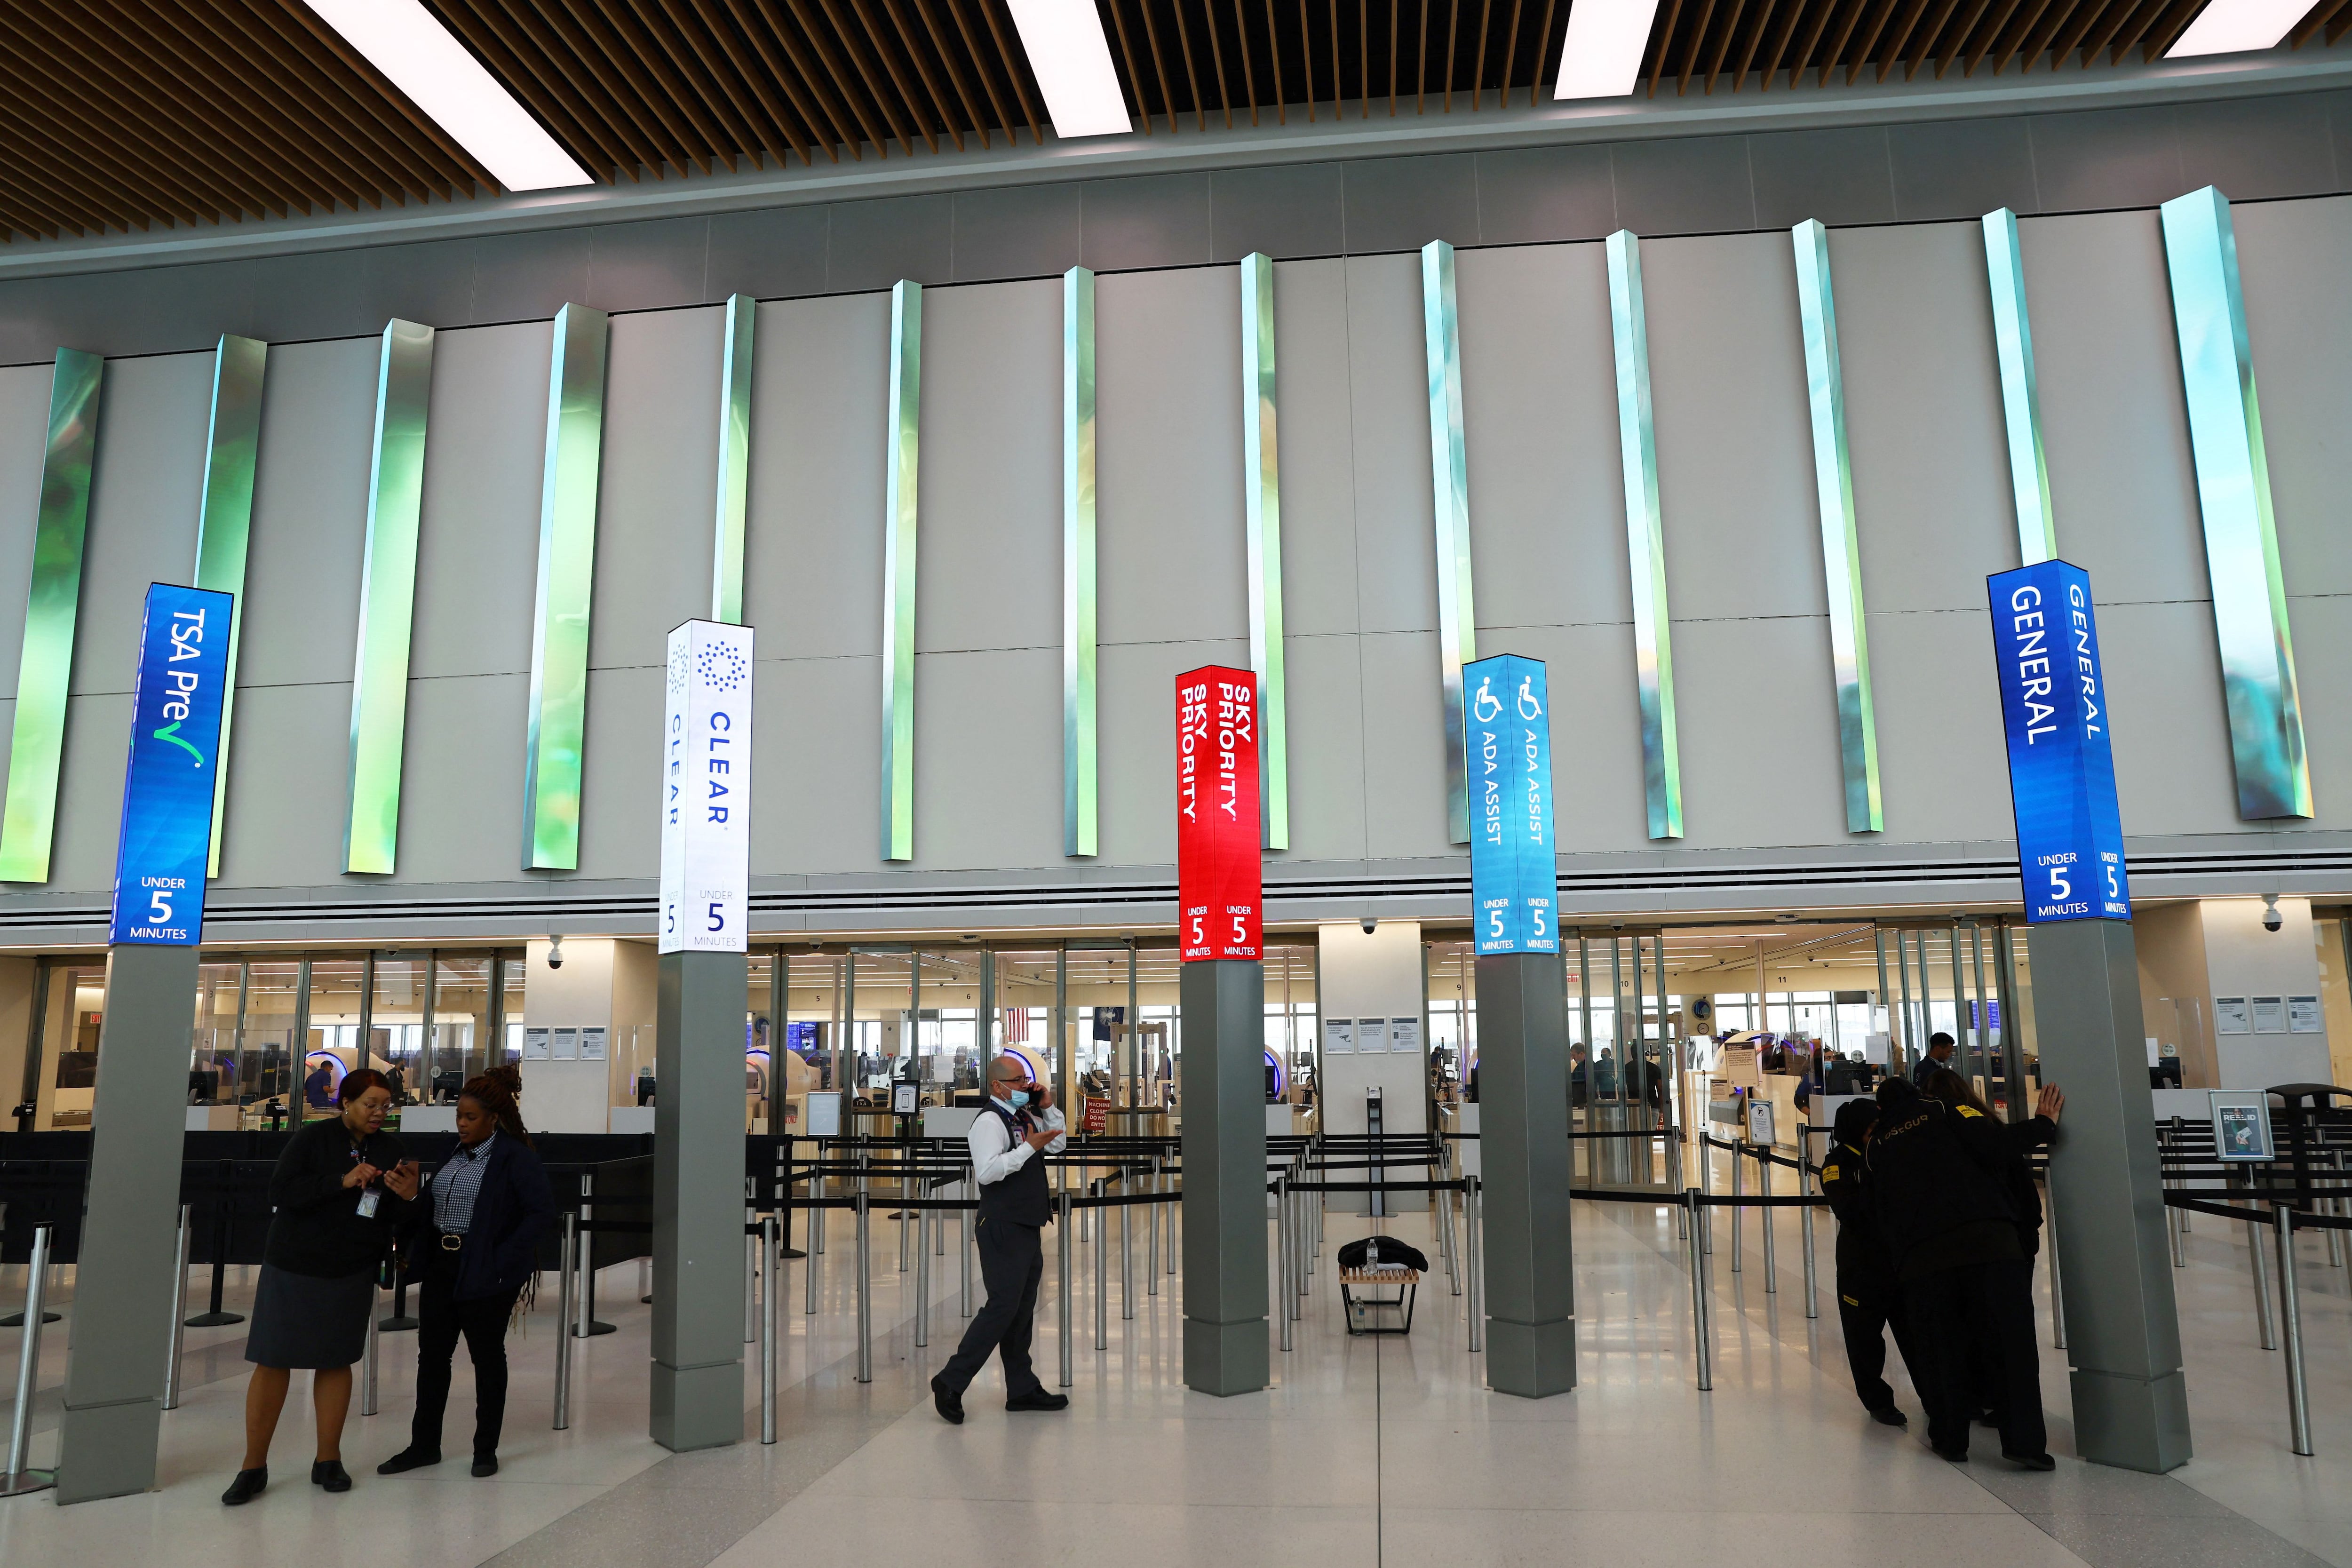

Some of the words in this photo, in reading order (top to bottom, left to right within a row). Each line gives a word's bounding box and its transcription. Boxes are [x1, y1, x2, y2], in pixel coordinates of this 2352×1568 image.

[168, 608, 205, 662] TSA
[2011, 586, 2057, 745] GENERAL
[2070, 584, 2100, 740] GENERAL
[163, 670, 199, 720] Pre
[1194, 684, 1207, 739] SKY
[1235, 685, 1251, 742] SKY
[1181, 687, 1196, 820] PRIORITY
[1218, 682, 1236, 818] PRIORITY
[1483, 732, 1497, 775] ADA
[1525, 729, 1538, 772] ADA
[670, 714, 681, 826] CLEAR
[708, 712, 731, 823] CLEAR
[1485, 780, 1501, 845] ASSIST
[1527, 778, 1542, 845] ASSIST
[2038, 852, 2078, 866] UNDER
[2101, 852, 2118, 863] UNDER
[142, 876, 185, 889] UNDER
[700, 890, 732, 900] UNDER
[2050, 867, 2071, 900] 5
[2106, 866, 2118, 898] 5
[149, 891, 173, 923] 5
[1188, 906, 1208, 916] UNDER
[1227, 905, 1251, 915] UNDER
[1484, 898, 1509, 909] UNDER
[1528, 898, 1549, 907] UNDER
[2038, 902, 2089, 916] MINUTES
[2105, 902, 2127, 914] MINUTES
[668, 904, 674, 933] 5
[708, 903, 724, 931] 5
[1193, 917, 1203, 944] 5
[1233, 916, 1246, 943] 5
[1491, 910, 1504, 938] 5
[1534, 909, 1545, 936] 5
[130, 927, 187, 939] MINUTES
[694, 936, 736, 946] MINUTES
[1482, 939, 1514, 950] MINUTES
[1527, 939, 1554, 949] MINUTES
[1186, 947, 1211, 957] MINUTES
[1224, 946, 1255, 955] MINUTES
[1567, 974, 1578, 983] EXIT
[91, 1014, 100, 1023] EXIT
